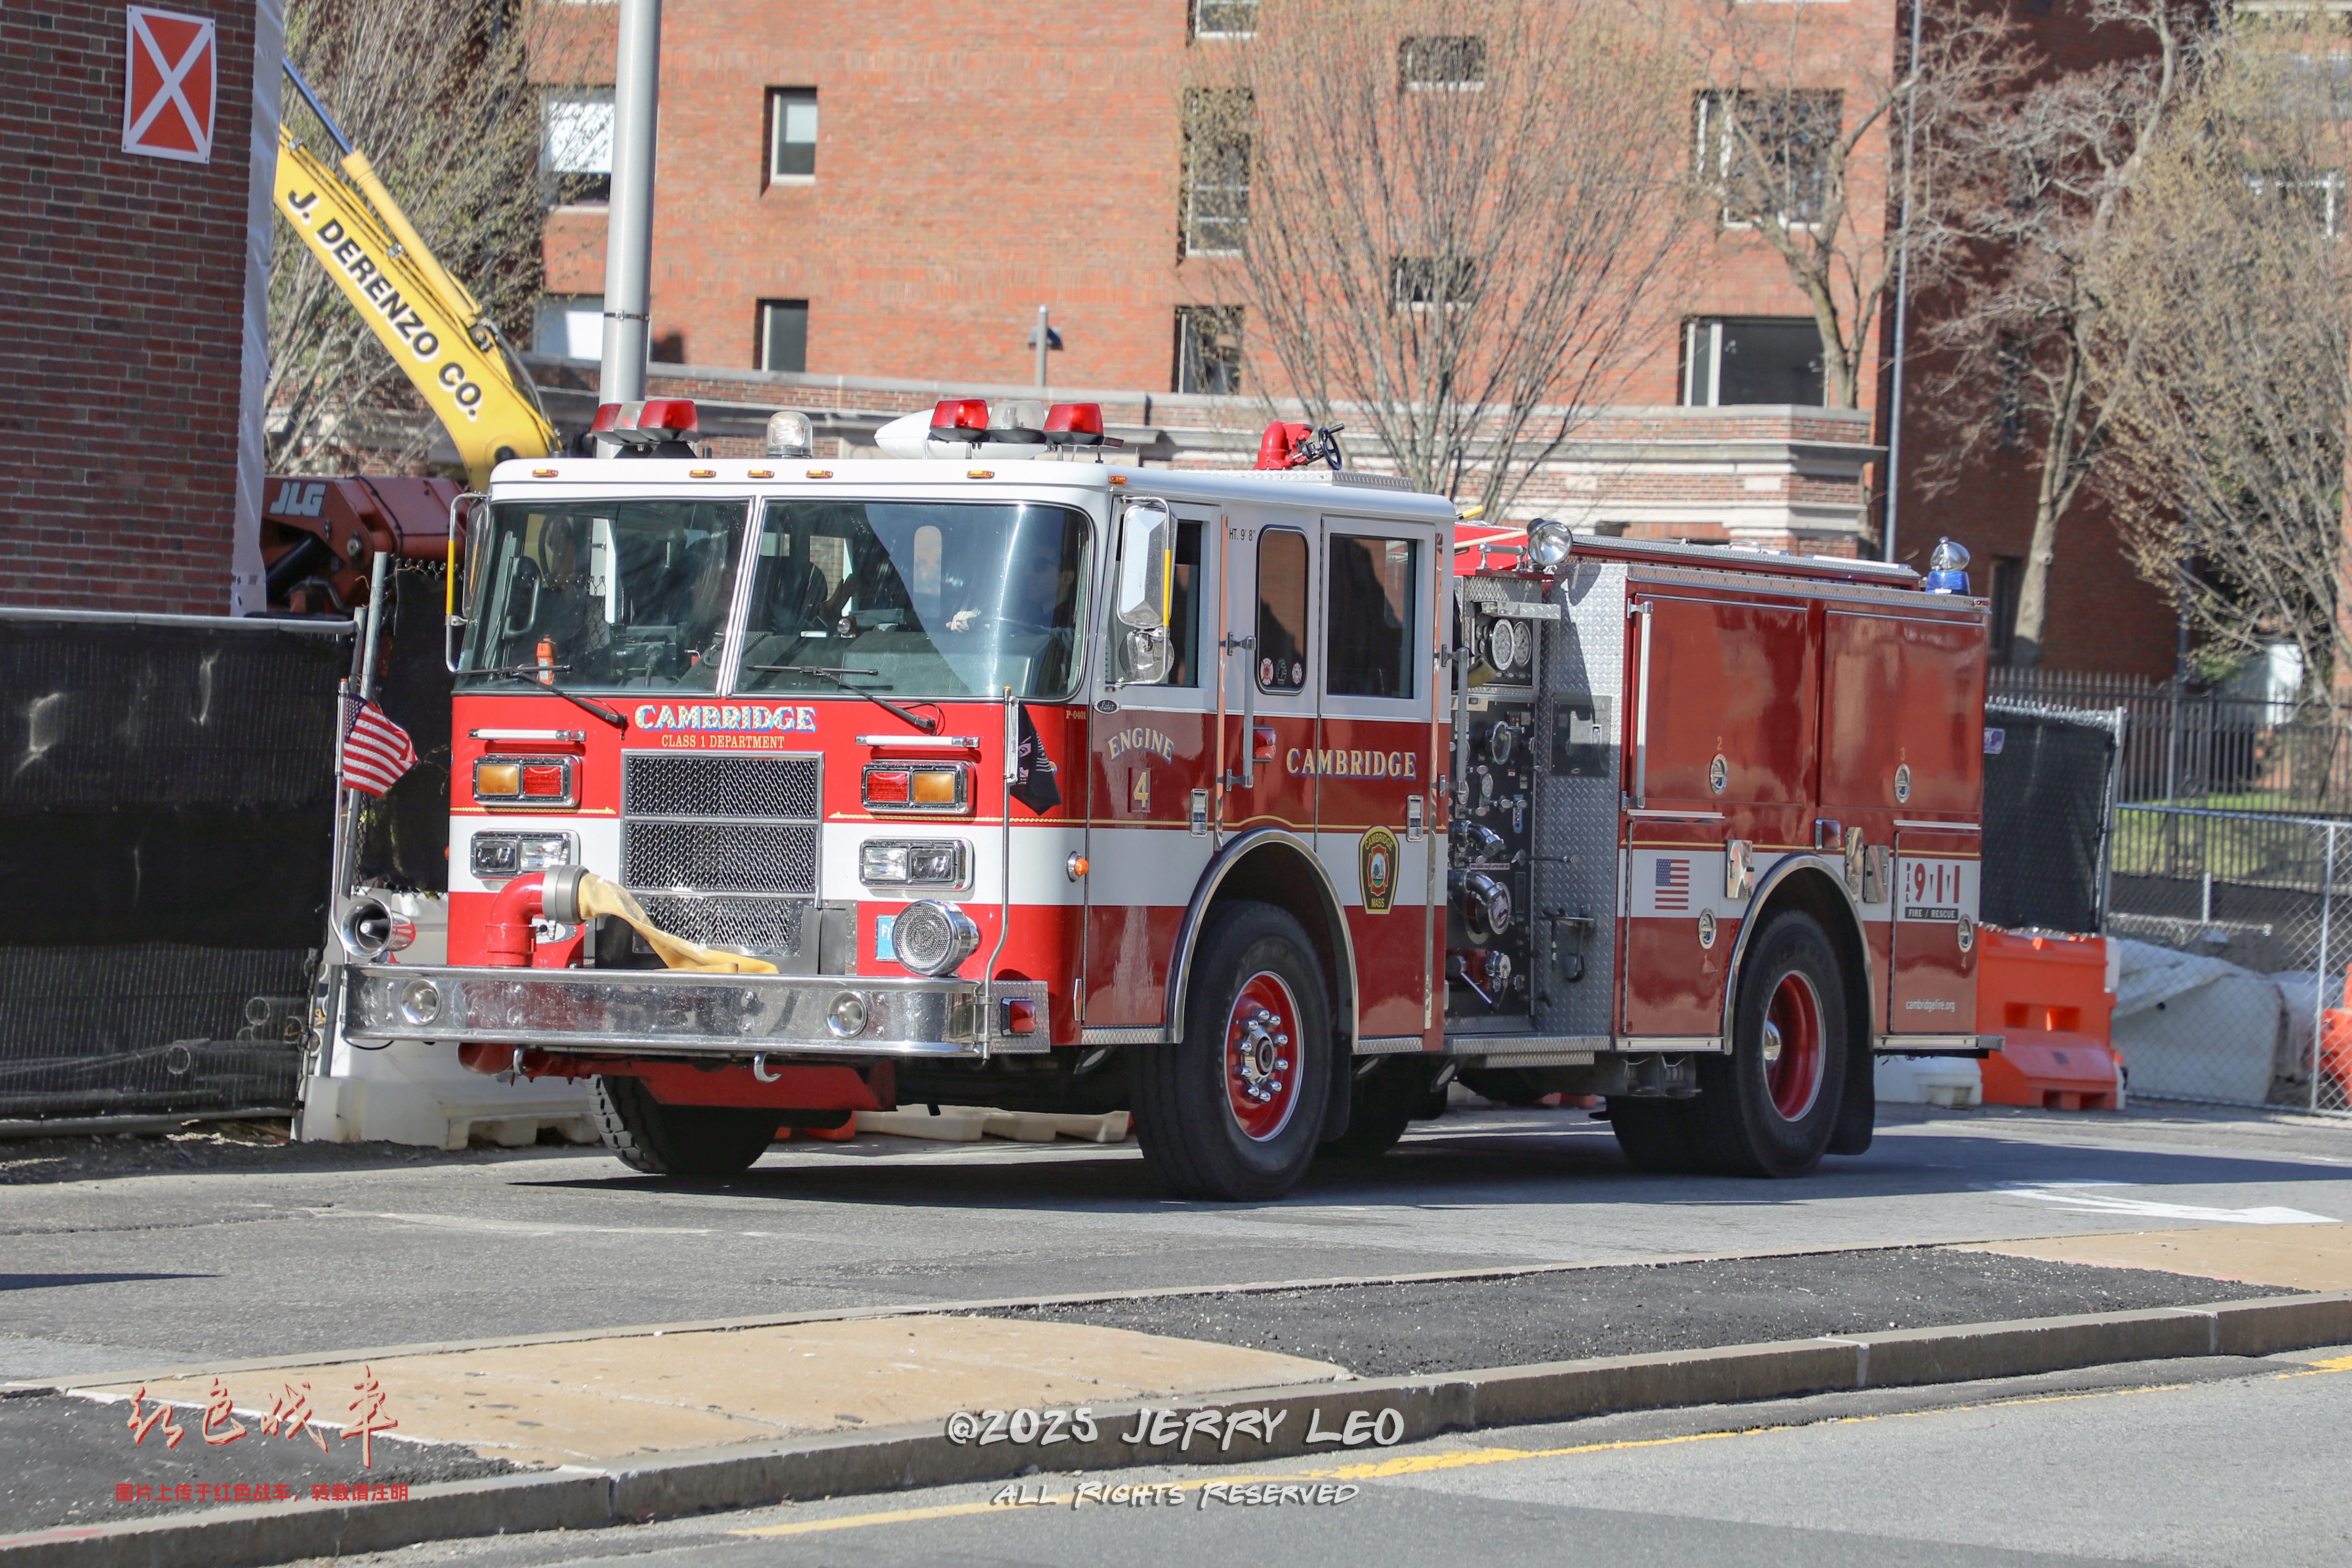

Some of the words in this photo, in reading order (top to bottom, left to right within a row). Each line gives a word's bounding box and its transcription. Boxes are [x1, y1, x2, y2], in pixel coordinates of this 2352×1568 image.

[287, 188, 317, 222] J.
[315, 217, 439, 362] DERENZO
[438, 362, 483, 421] CO.
[269, 481, 326, 517] JLG
[1229, 528, 1238, 540] HT.
[634, 704, 817, 732] CAMBRIDGE
[1066, 710, 1087, 720] P-0401
[661, 735, 696, 747] CLASS
[700, 736, 706, 748] 1
[709, 735, 785, 749] DEPARTMENT
[1107, 727, 1175, 763] ENGINE
[1716, 736, 1723, 751] 2
[1900, 747, 1906, 761] 3
[1286, 748, 1417, 780] CAMBRIDGE
[1132, 771, 1150, 810] 4
[1365, 832, 1394, 851] CAMBRIDGE
[1371, 898, 1385, 908] MASS
[1909, 909, 1923, 917] FIRE
[1931, 909, 1956, 919] RESCUE
[1906, 998, 1955, 1013] cambridgefire.org
